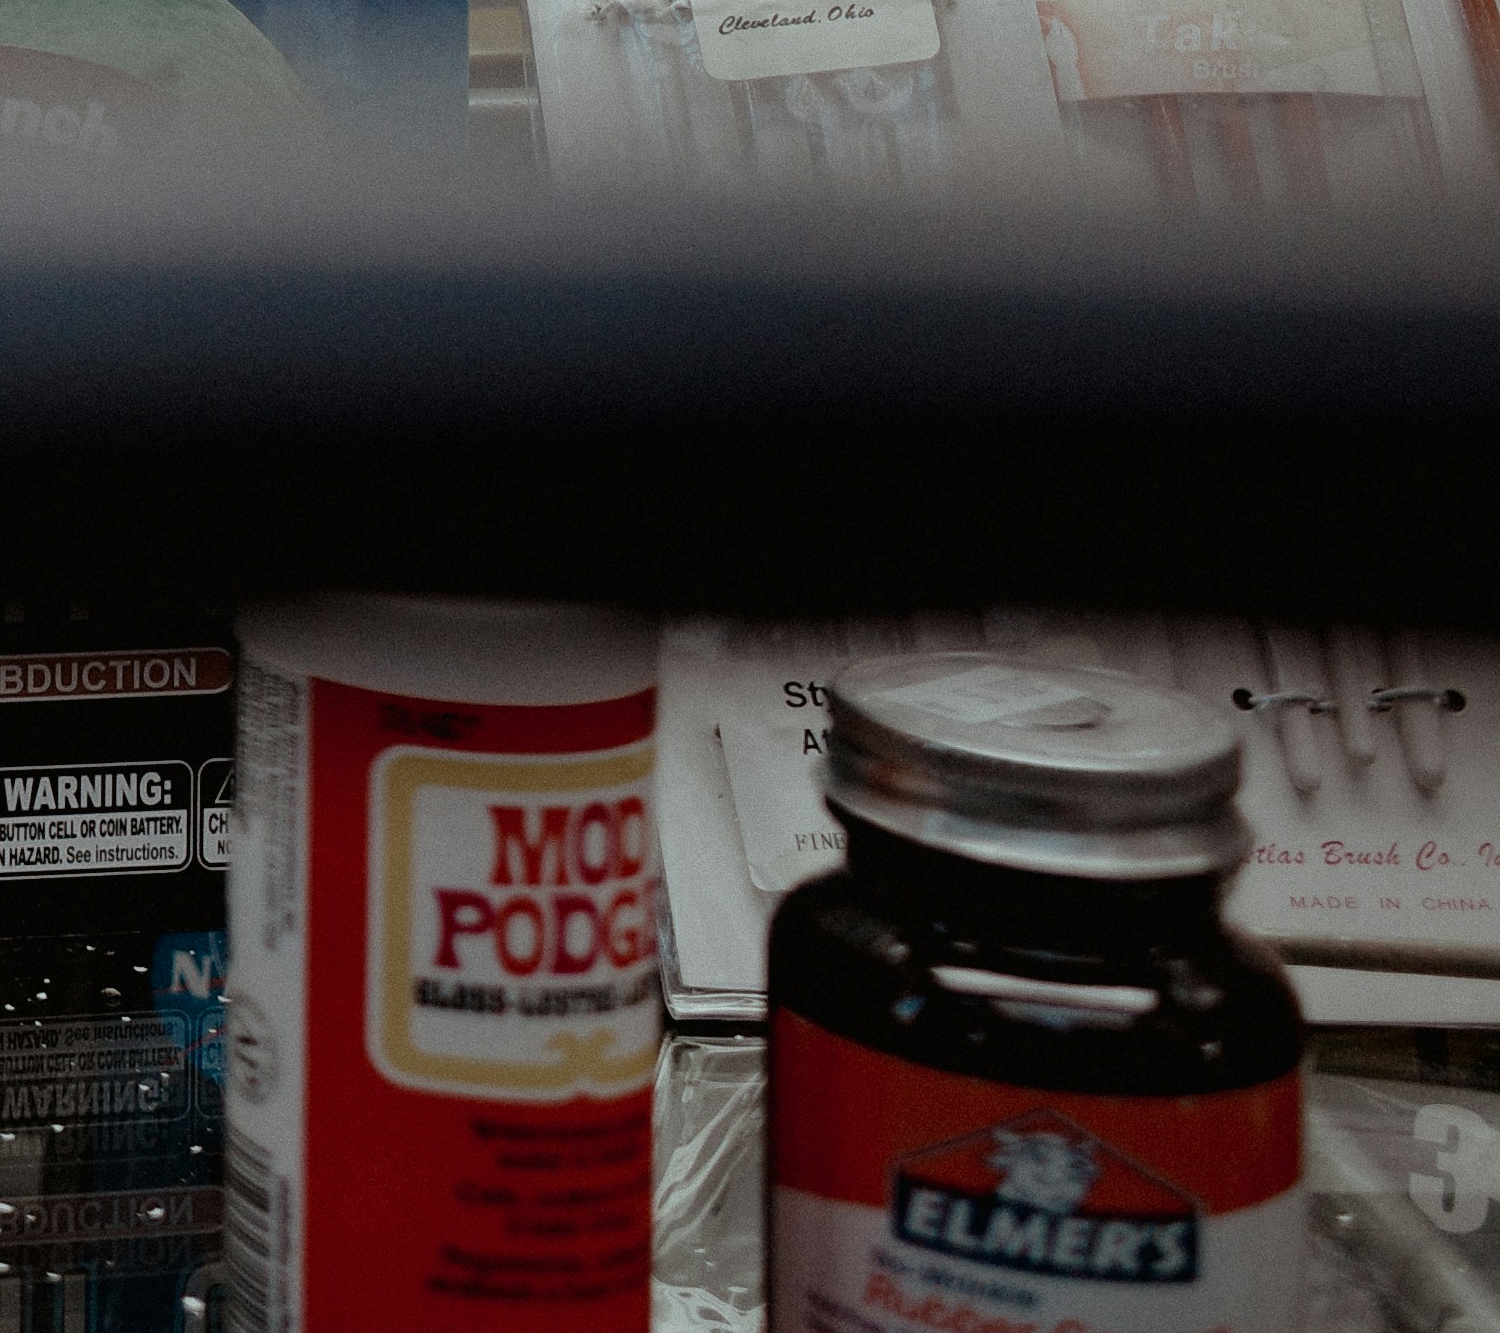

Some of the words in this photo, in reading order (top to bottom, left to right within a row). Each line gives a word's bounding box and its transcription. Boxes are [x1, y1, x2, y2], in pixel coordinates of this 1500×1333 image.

[827, 3, 876, 22] Ohio
[3, 770, 172, 813] WARNING:
[0, 821, 46, 843] BUTTON
[48, 820, 78, 840] CELL
[80, 819, 97, 838] OR
[99, 817, 128, 838] COIN
[130, 815, 184, 836] BATTERY.
[8, 845, 64, 867] HAZARD.
[65, 845, 92, 864] See
[94, 841, 180, 864] instructions.
[1248, 844, 1306, 865] tlas
[1320, 839, 1401, 866] Brush
[1289, 895, 1359, 910] MADE
[1379, 896, 1402, 910] IN
[1421, 896, 1494, 911] CHINA
[433, 887, 658, 977] PODG
[902, 1186, 1192, 1280] ELMER'S
